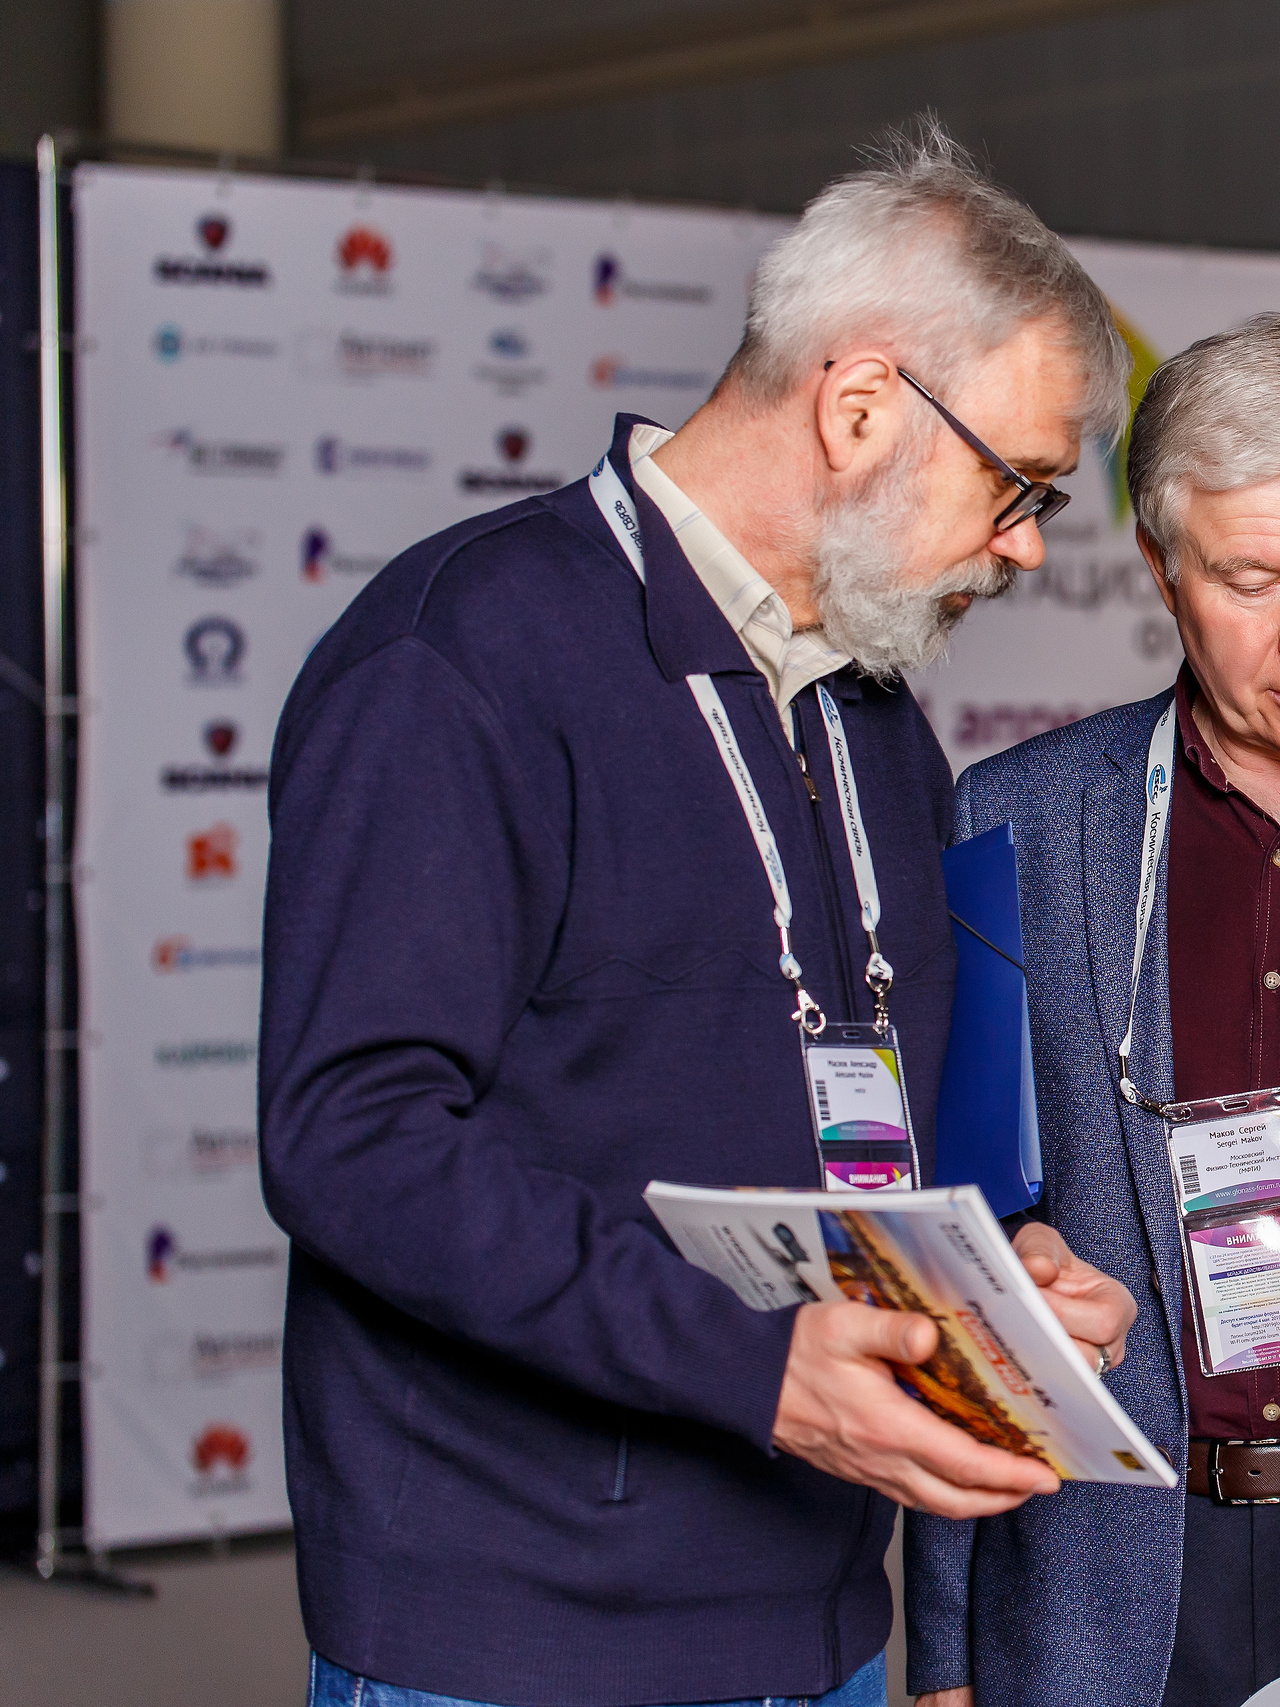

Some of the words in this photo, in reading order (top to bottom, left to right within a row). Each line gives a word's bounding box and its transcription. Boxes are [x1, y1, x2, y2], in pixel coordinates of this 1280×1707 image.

[1142, 811, 1162, 894] Космическая
[1209, 1129, 1235, 1139] Маков
[1239, 1124, 1267, 1136] Сергей
[1217, 1140, 1237, 1149] Sergei
[1241, 1135, 1263, 1144] Makov
[1230, 1150, 1265, 1161] Московский
[1206, 1158, 1265, 1172] Физико-Технический
[1239, 1165, 1261, 1175] (МФТИ)
[1226, 1235, 1261, 1246] ВНИМ
